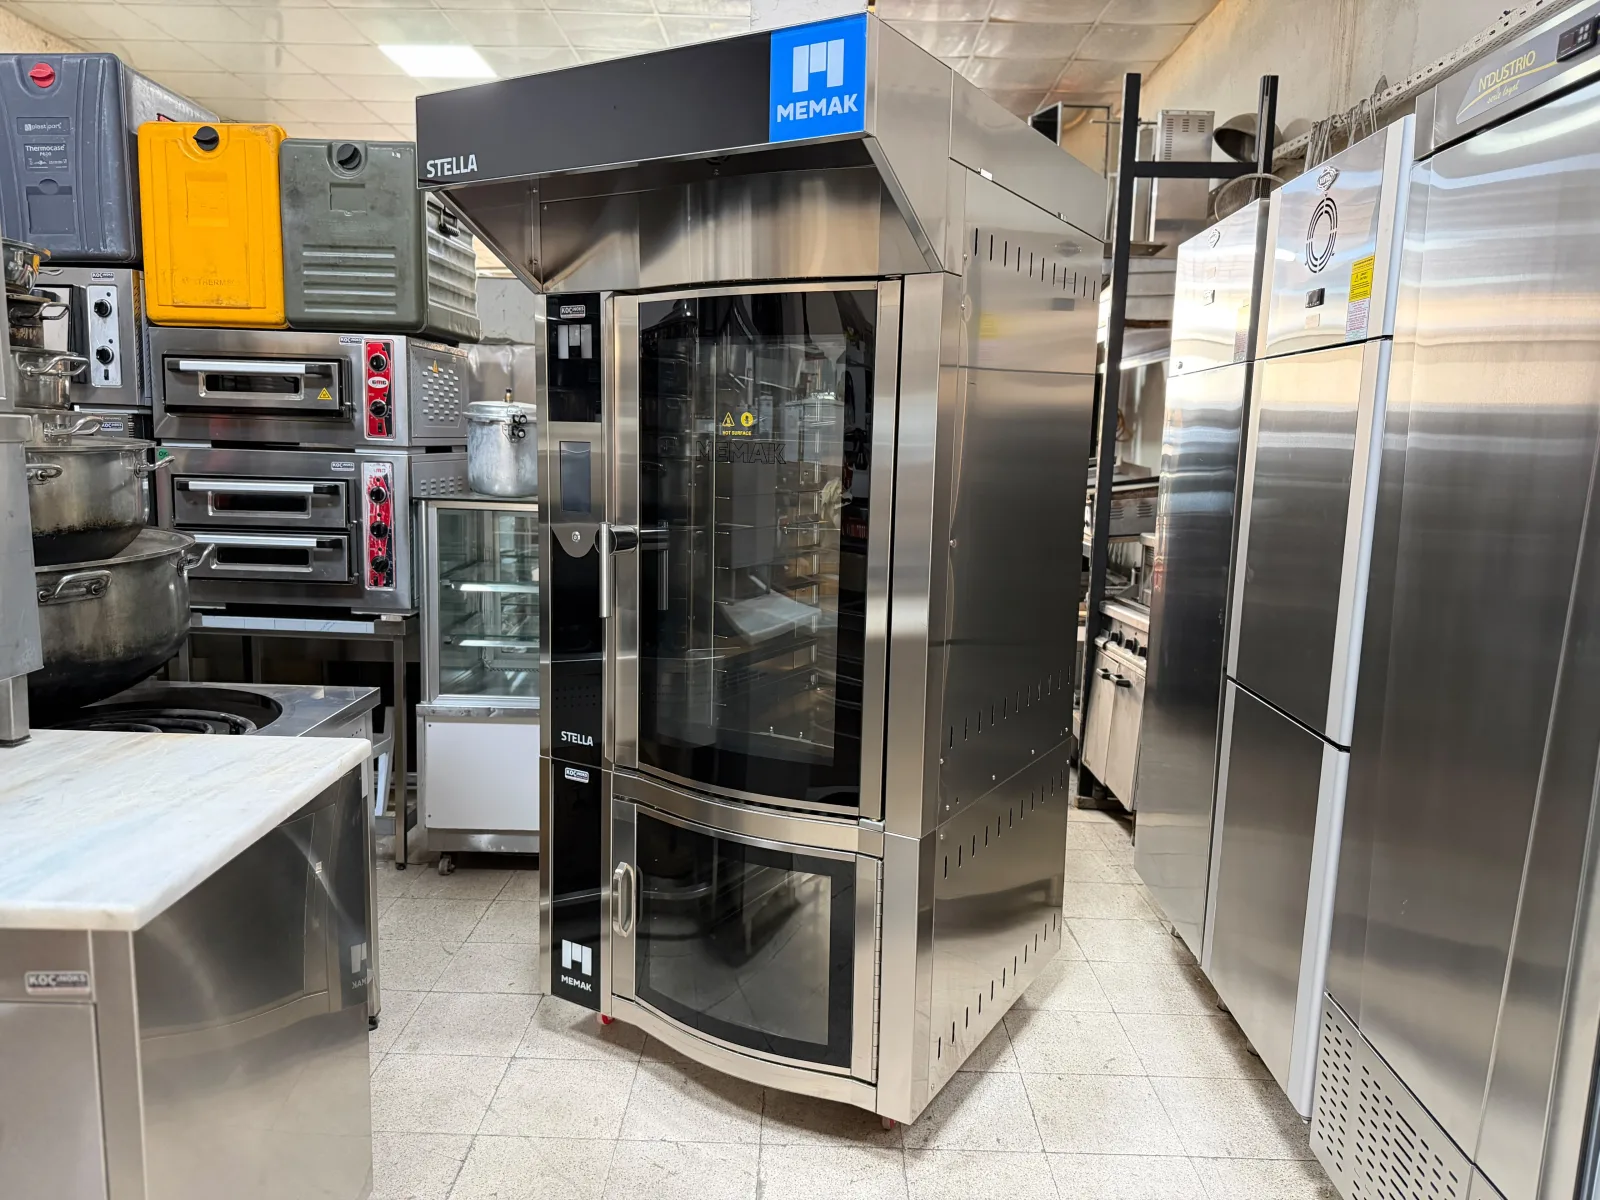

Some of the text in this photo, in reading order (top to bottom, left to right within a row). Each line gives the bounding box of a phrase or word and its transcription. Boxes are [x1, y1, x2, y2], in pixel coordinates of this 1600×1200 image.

[776, 93, 858, 123] MEMAK
[426, 153, 478, 178] STELLA
[696, 441, 787, 465] MEMAK
[561, 731, 594, 747] STELLA
[561, 974, 592, 992] MEMAK
